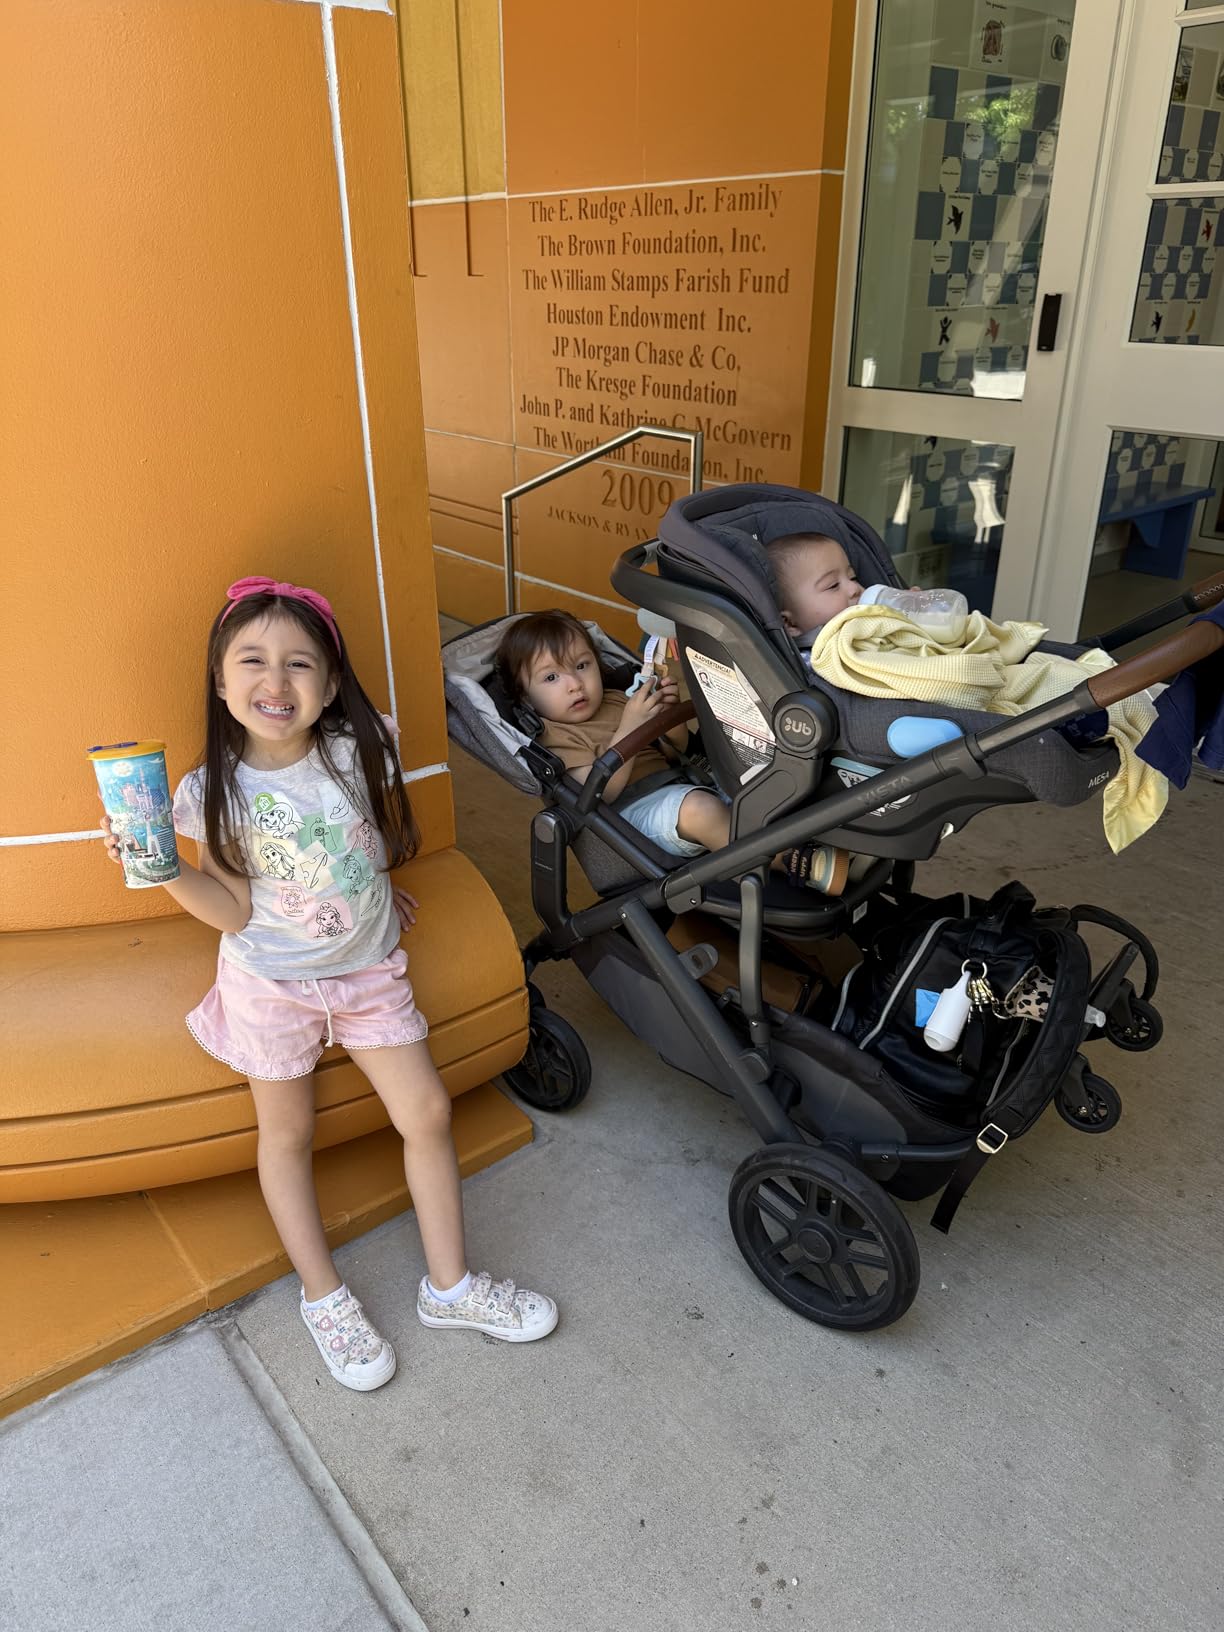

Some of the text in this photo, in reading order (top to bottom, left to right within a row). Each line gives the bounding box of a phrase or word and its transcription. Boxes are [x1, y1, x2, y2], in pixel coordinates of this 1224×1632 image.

[529, 183, 782, 225] The E. Rudge Allen, Jr. Family
[537, 227, 766, 257] The Brown Foundation, Inc.
[522, 268, 790, 298] The William Stamps Farish Fund
[546, 303, 751, 333] Houston Endowment Inc.
[635, 341, 683, 366] Chase
[689, 344, 704, 368] &
[556, 367, 737, 406] The Kresge Foundation
[520, 394, 550, 416] John
[554, 399, 566, 419] P.
[570, 404, 594, 423] and
[695, 416, 792, 451] McGovern
[533, 426, 558, 449] The
[602, 469, 675, 519] 2009
[547, 505, 600, 529] JACKSON
[602, 519, 611, 534] &
[857, 775, 913, 805] VISTA
